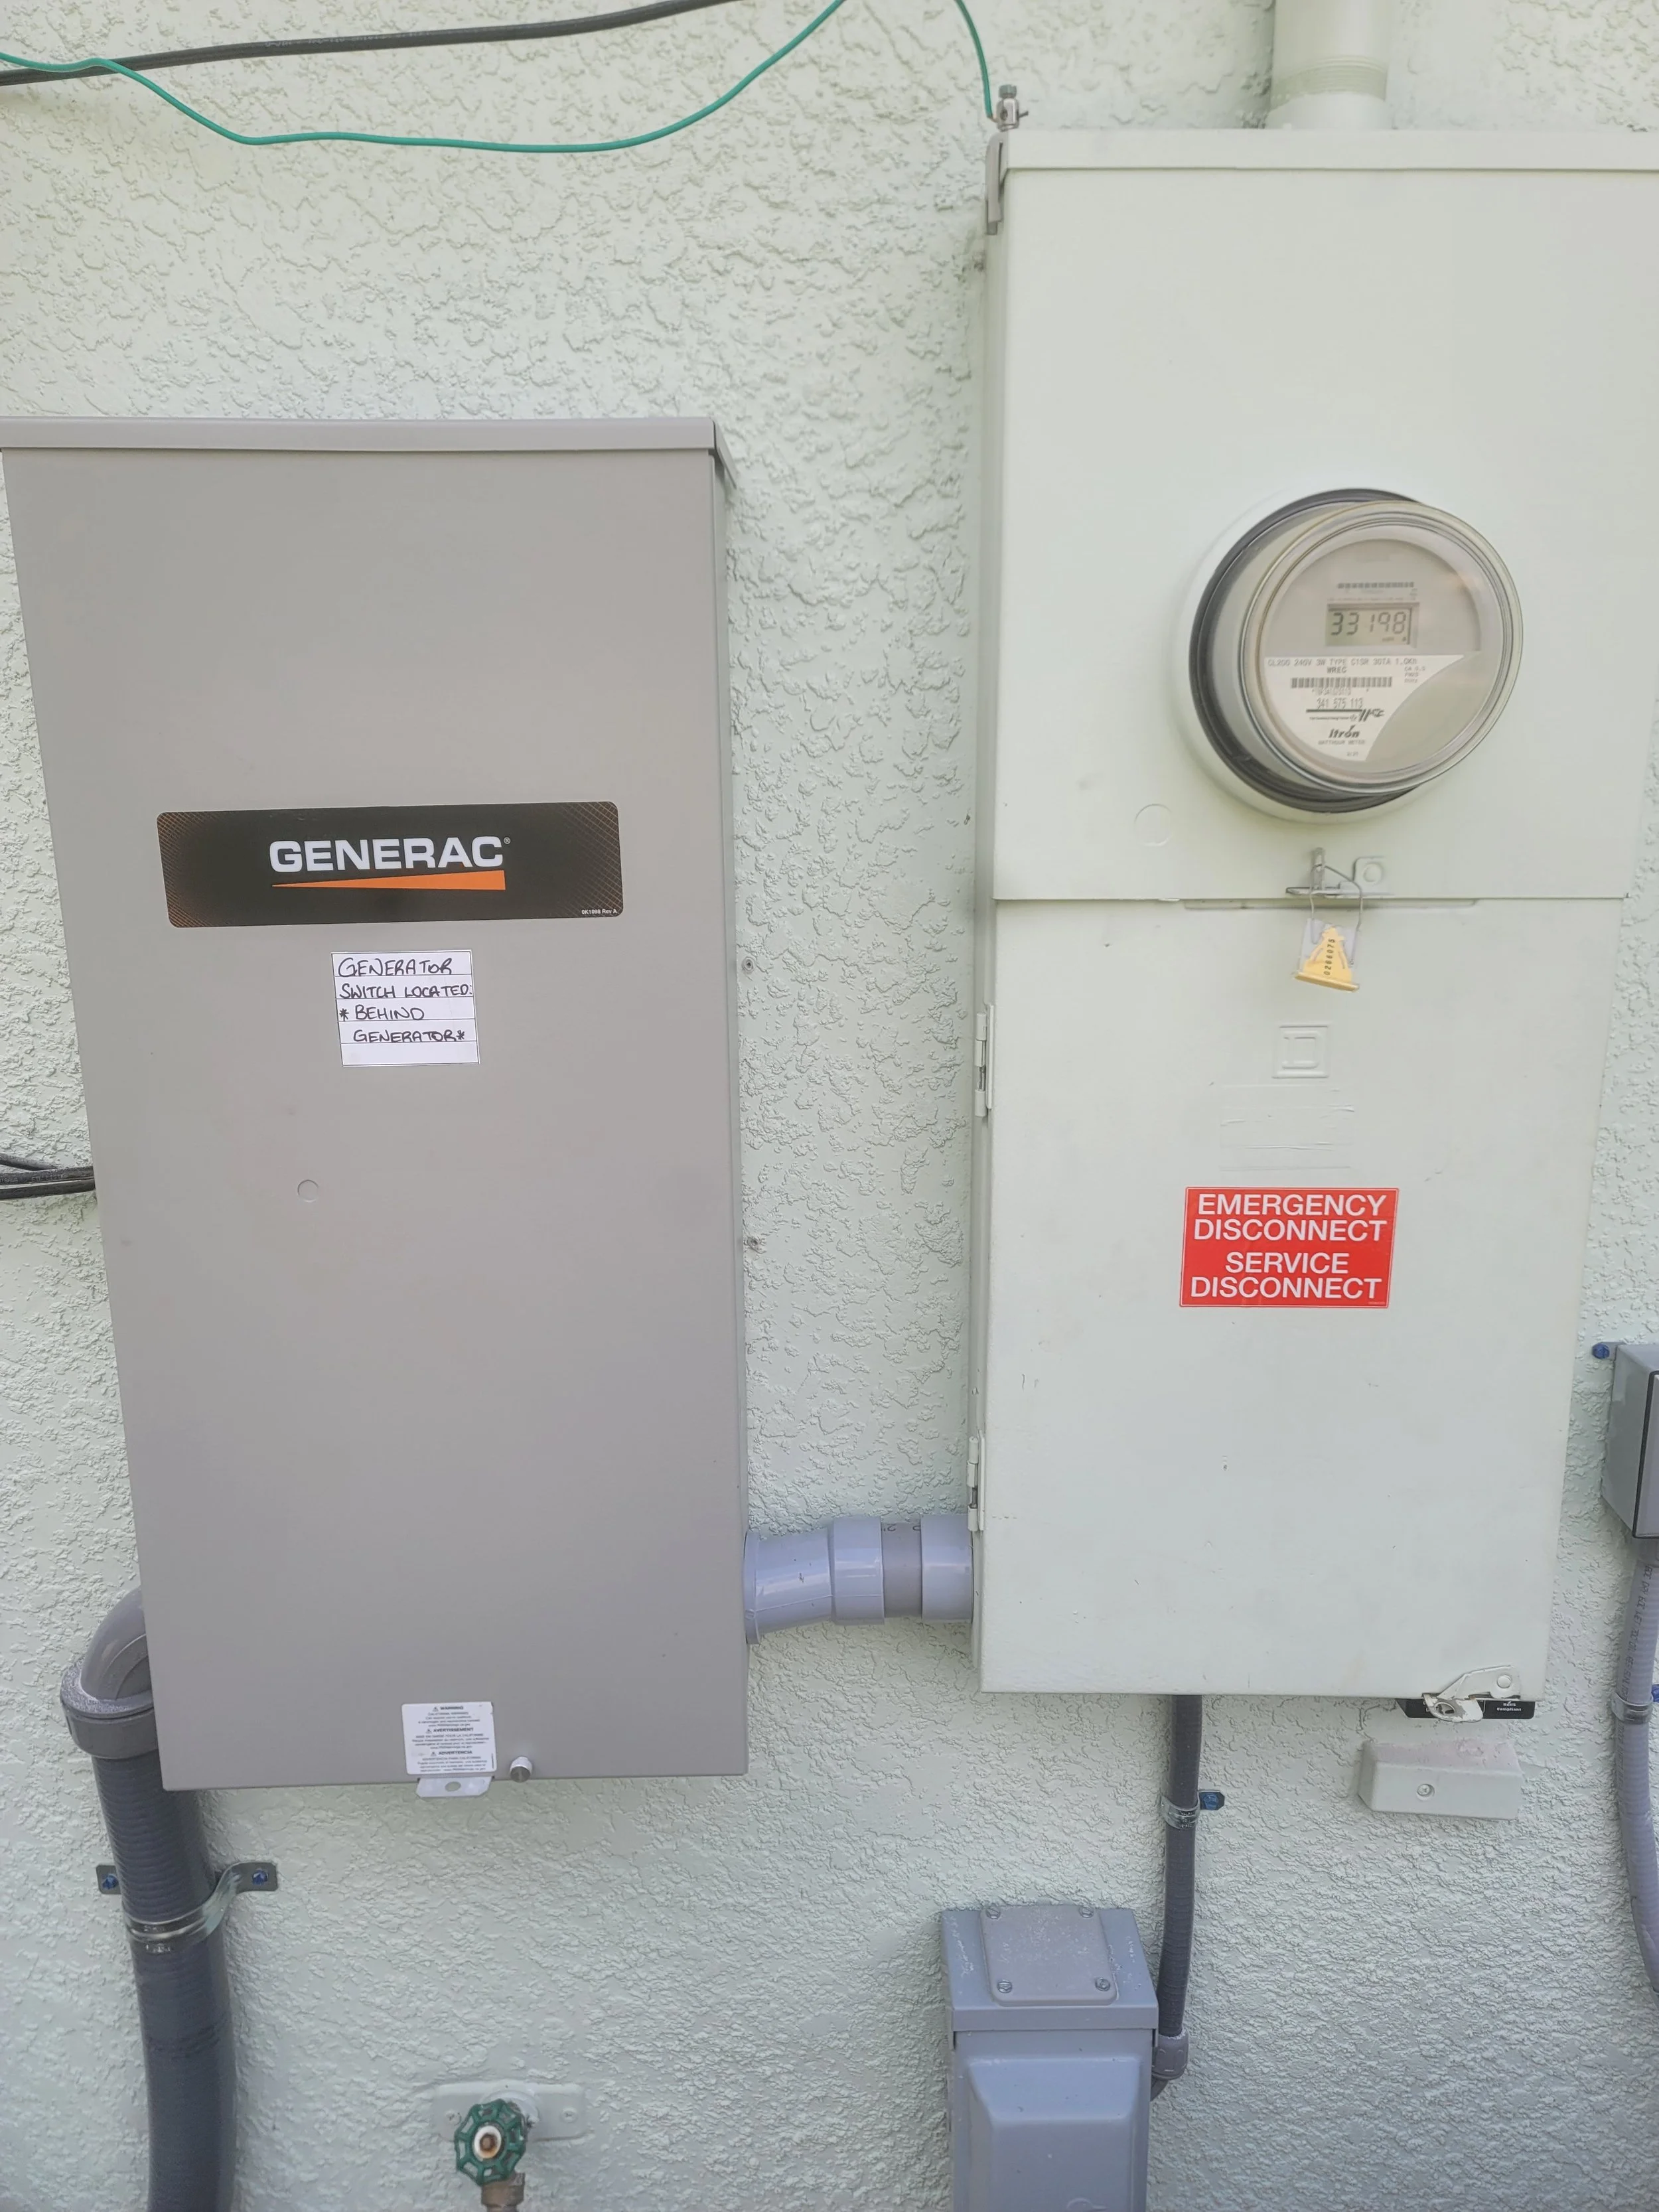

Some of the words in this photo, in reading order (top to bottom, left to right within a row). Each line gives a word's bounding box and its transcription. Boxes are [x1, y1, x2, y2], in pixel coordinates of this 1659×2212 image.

[1331, 611, 1406, 635] 33198
[269, 836, 504, 872] GENERAC
[338, 957, 453, 977] GENERATOR
[339, 983, 397, 998] SWITCH
[355, 1004, 425, 1020] BEHIND
[1197, 1193, 1387, 1216] EMERGENCY
[1194, 1218, 1387, 1242] DISCONNECT
[1225, 1251, 1349, 1274] SERVICE
[1190, 1276, 1382, 1299] DISCONNECT
